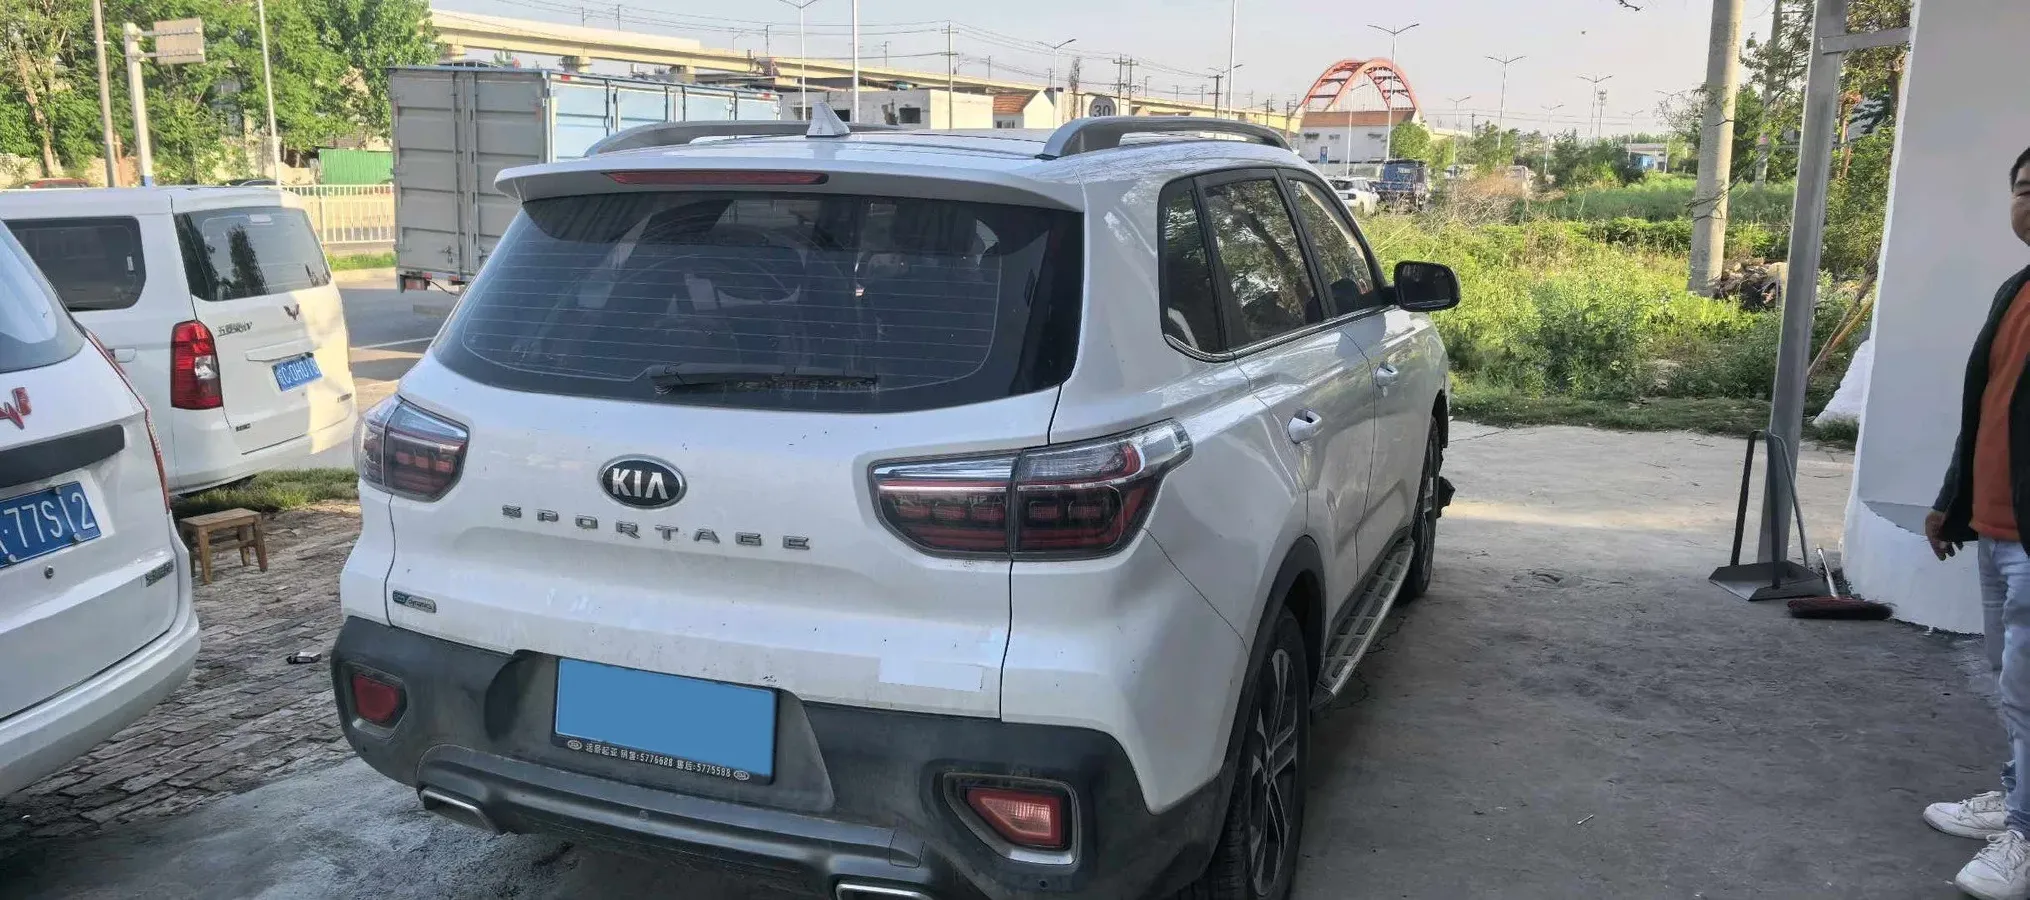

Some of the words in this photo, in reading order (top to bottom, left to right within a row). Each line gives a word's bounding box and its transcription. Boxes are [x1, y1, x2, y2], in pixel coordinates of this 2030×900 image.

[1093, 105, 1111, 117] 30
[611, 467, 668, 499] KIA
[0, 492, 95, 555] ·77S12
[502, 504, 810, 550] SPORTAGE
